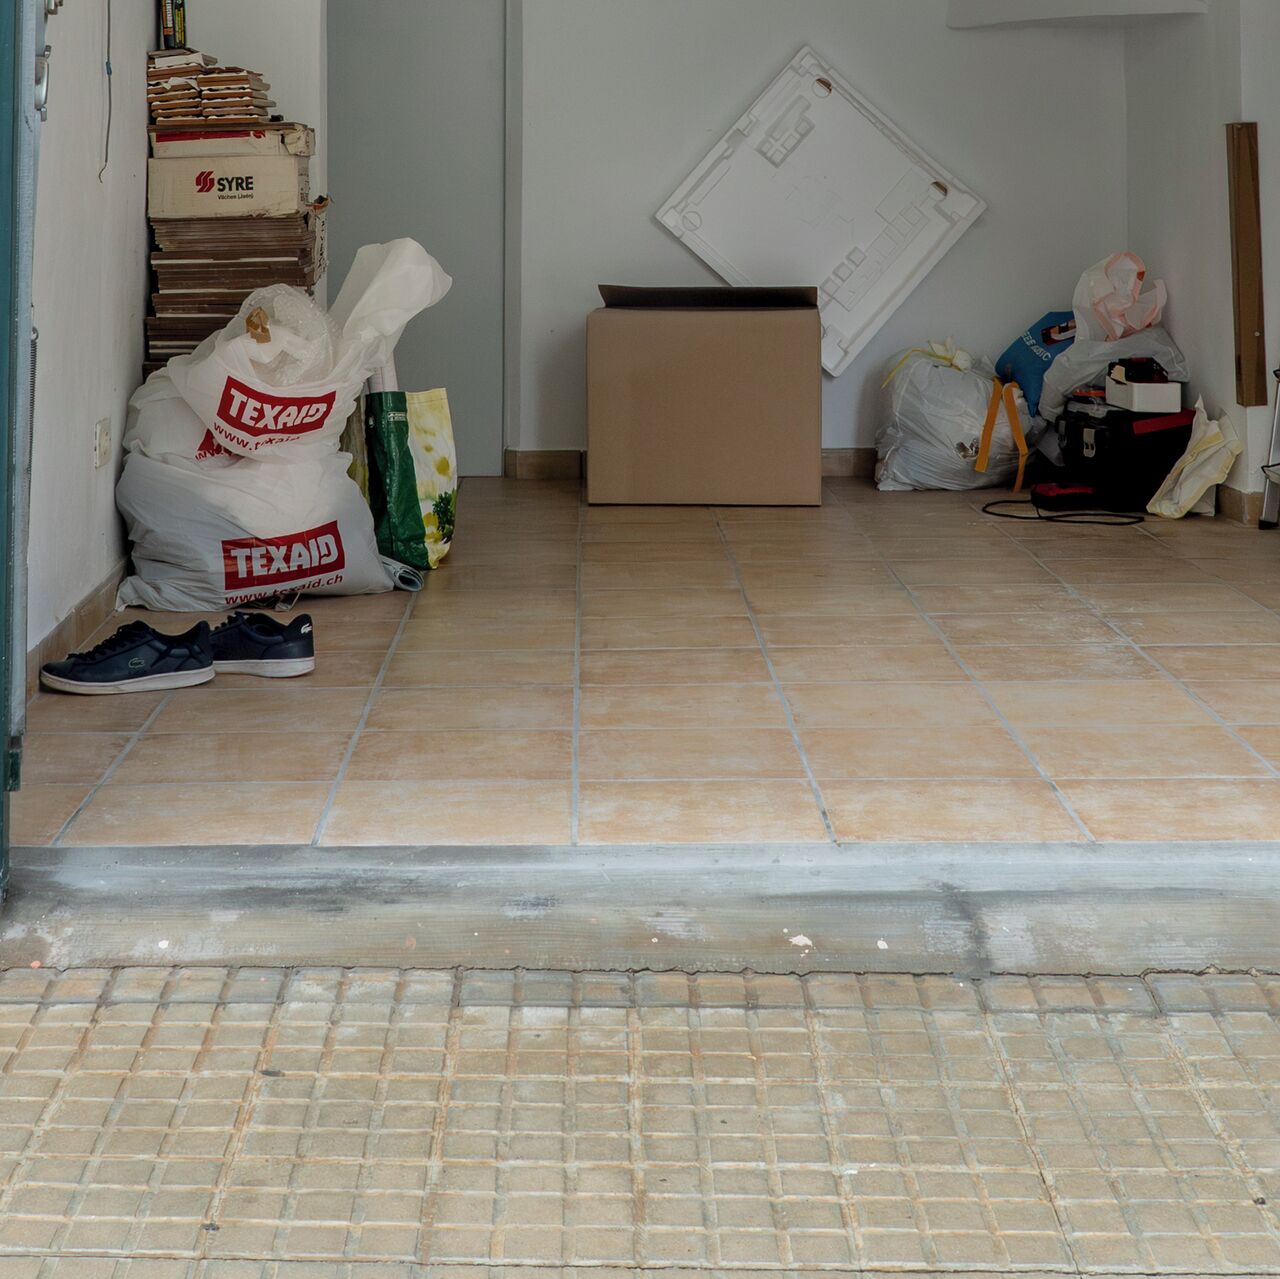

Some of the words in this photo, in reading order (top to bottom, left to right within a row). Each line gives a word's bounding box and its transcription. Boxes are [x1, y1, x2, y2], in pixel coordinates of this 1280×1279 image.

[217, 176, 253, 192] SYRE
[229, 387, 328, 430] TEXAID
[231, 534, 339, 579] TEXAID
